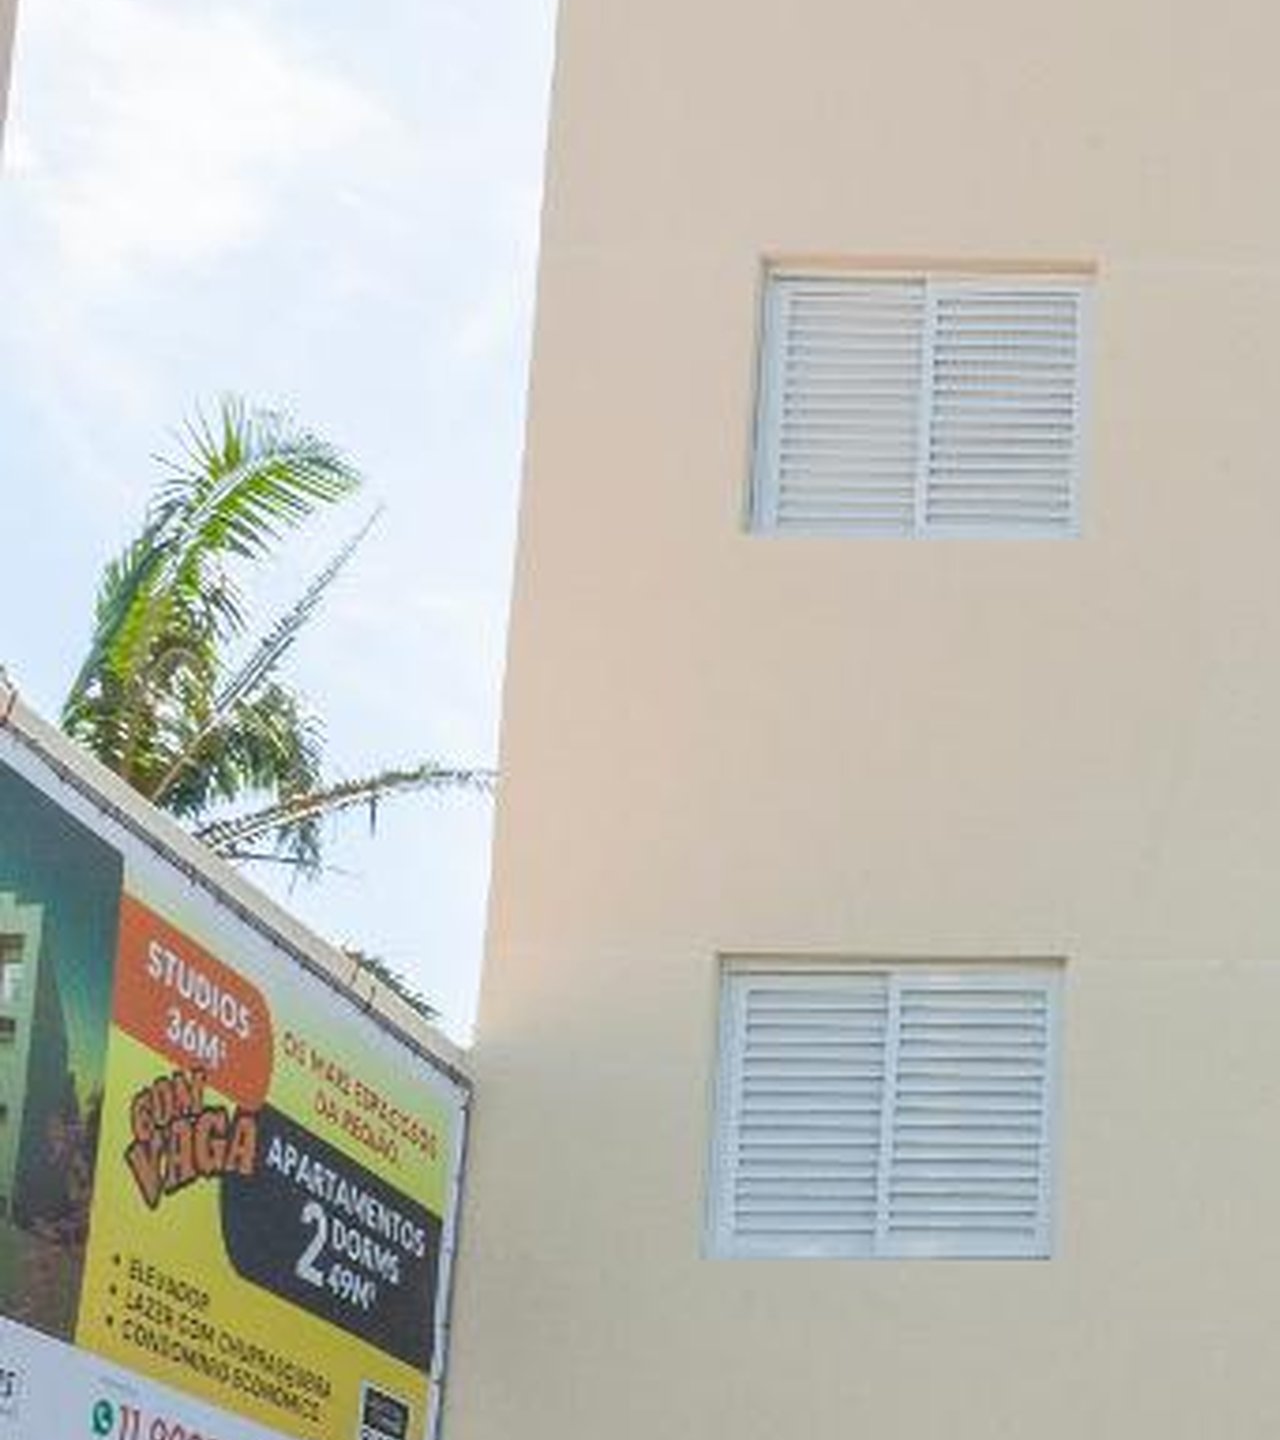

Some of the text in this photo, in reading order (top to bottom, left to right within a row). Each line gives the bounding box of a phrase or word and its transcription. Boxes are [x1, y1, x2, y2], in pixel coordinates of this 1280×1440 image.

[148, 941, 251, 1039] STUDIOS
[124, 1106, 257, 1210] VAGA
[266, 1136, 426, 1260] APARTAMENTOS
[295, 1200, 328, 1288] 2
